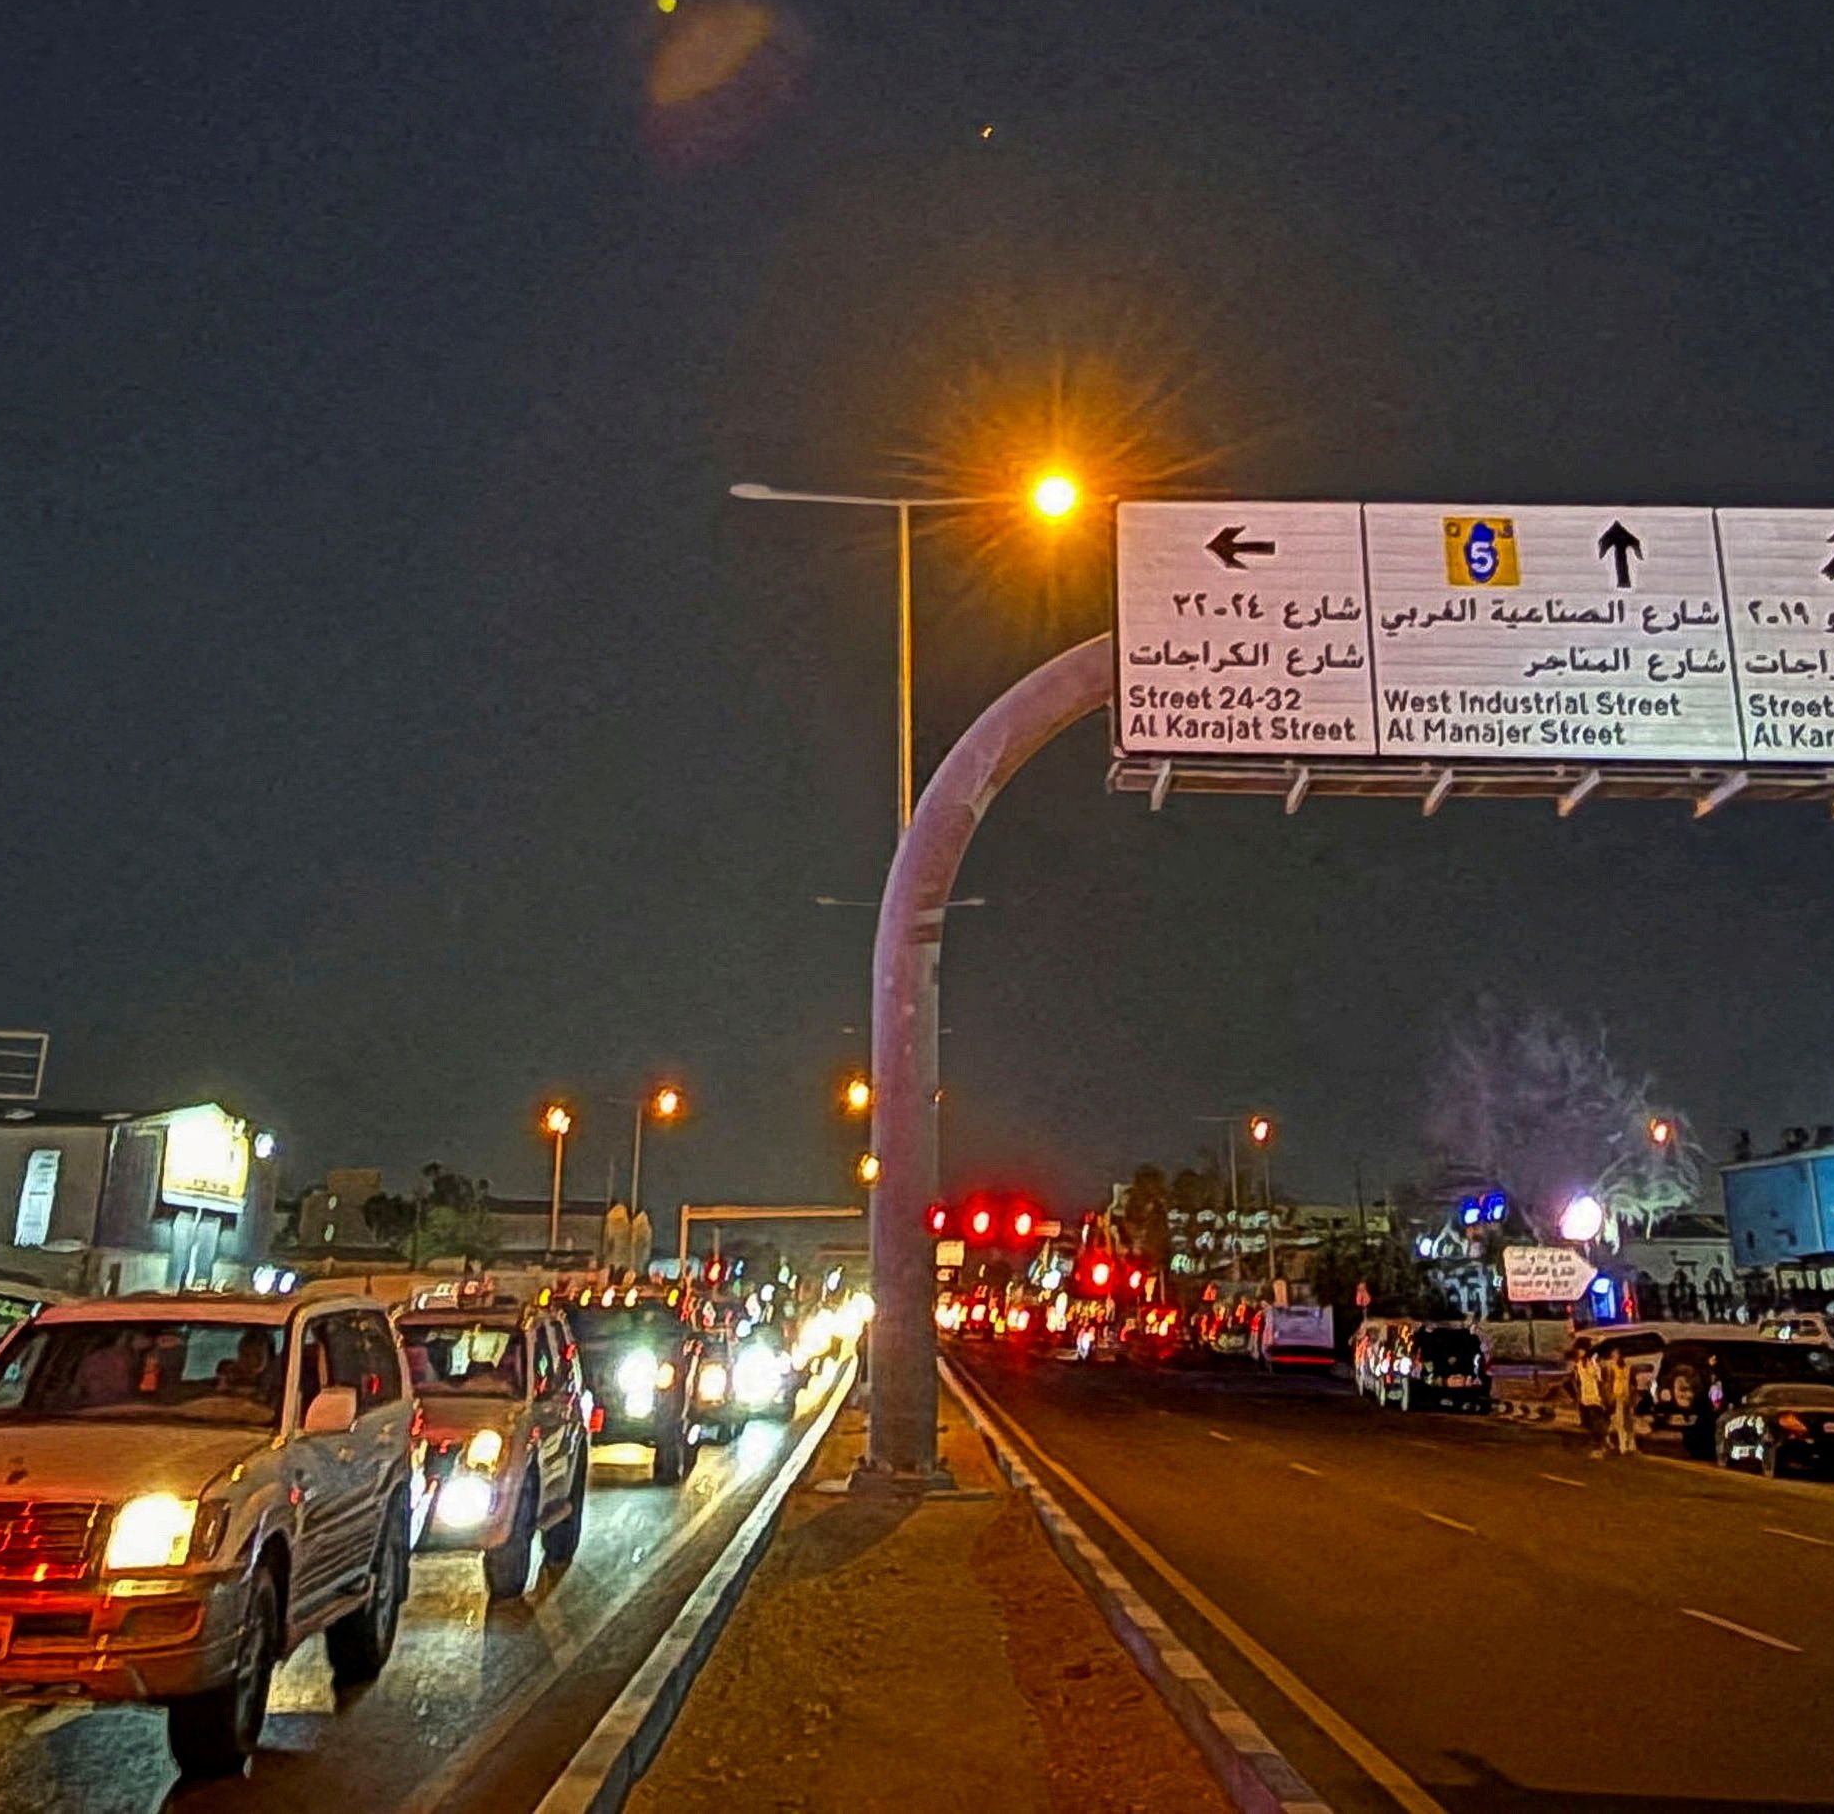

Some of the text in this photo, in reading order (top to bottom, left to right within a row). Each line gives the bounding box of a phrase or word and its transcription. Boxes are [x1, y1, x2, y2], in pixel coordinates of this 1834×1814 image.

[1470, 541, 1494, 573] 5
[1283, 595, 1362, 629] شارع
[1381, 597, 1720, 637] شارع الصناعية الغربي
[1128, 640, 1364, 677] شارع الكراجات
[1648, 648, 1726, 682] شارع
[1128, 684, 1302, 711] Street 24-32
[1383, 689, 1682, 716] West Industrial Street
[1128, 713, 1356, 744] Al Karajat Street
[1387, 717, 1627, 747] Al Manajer Street
[1753, 722, 1782, 748] Al
